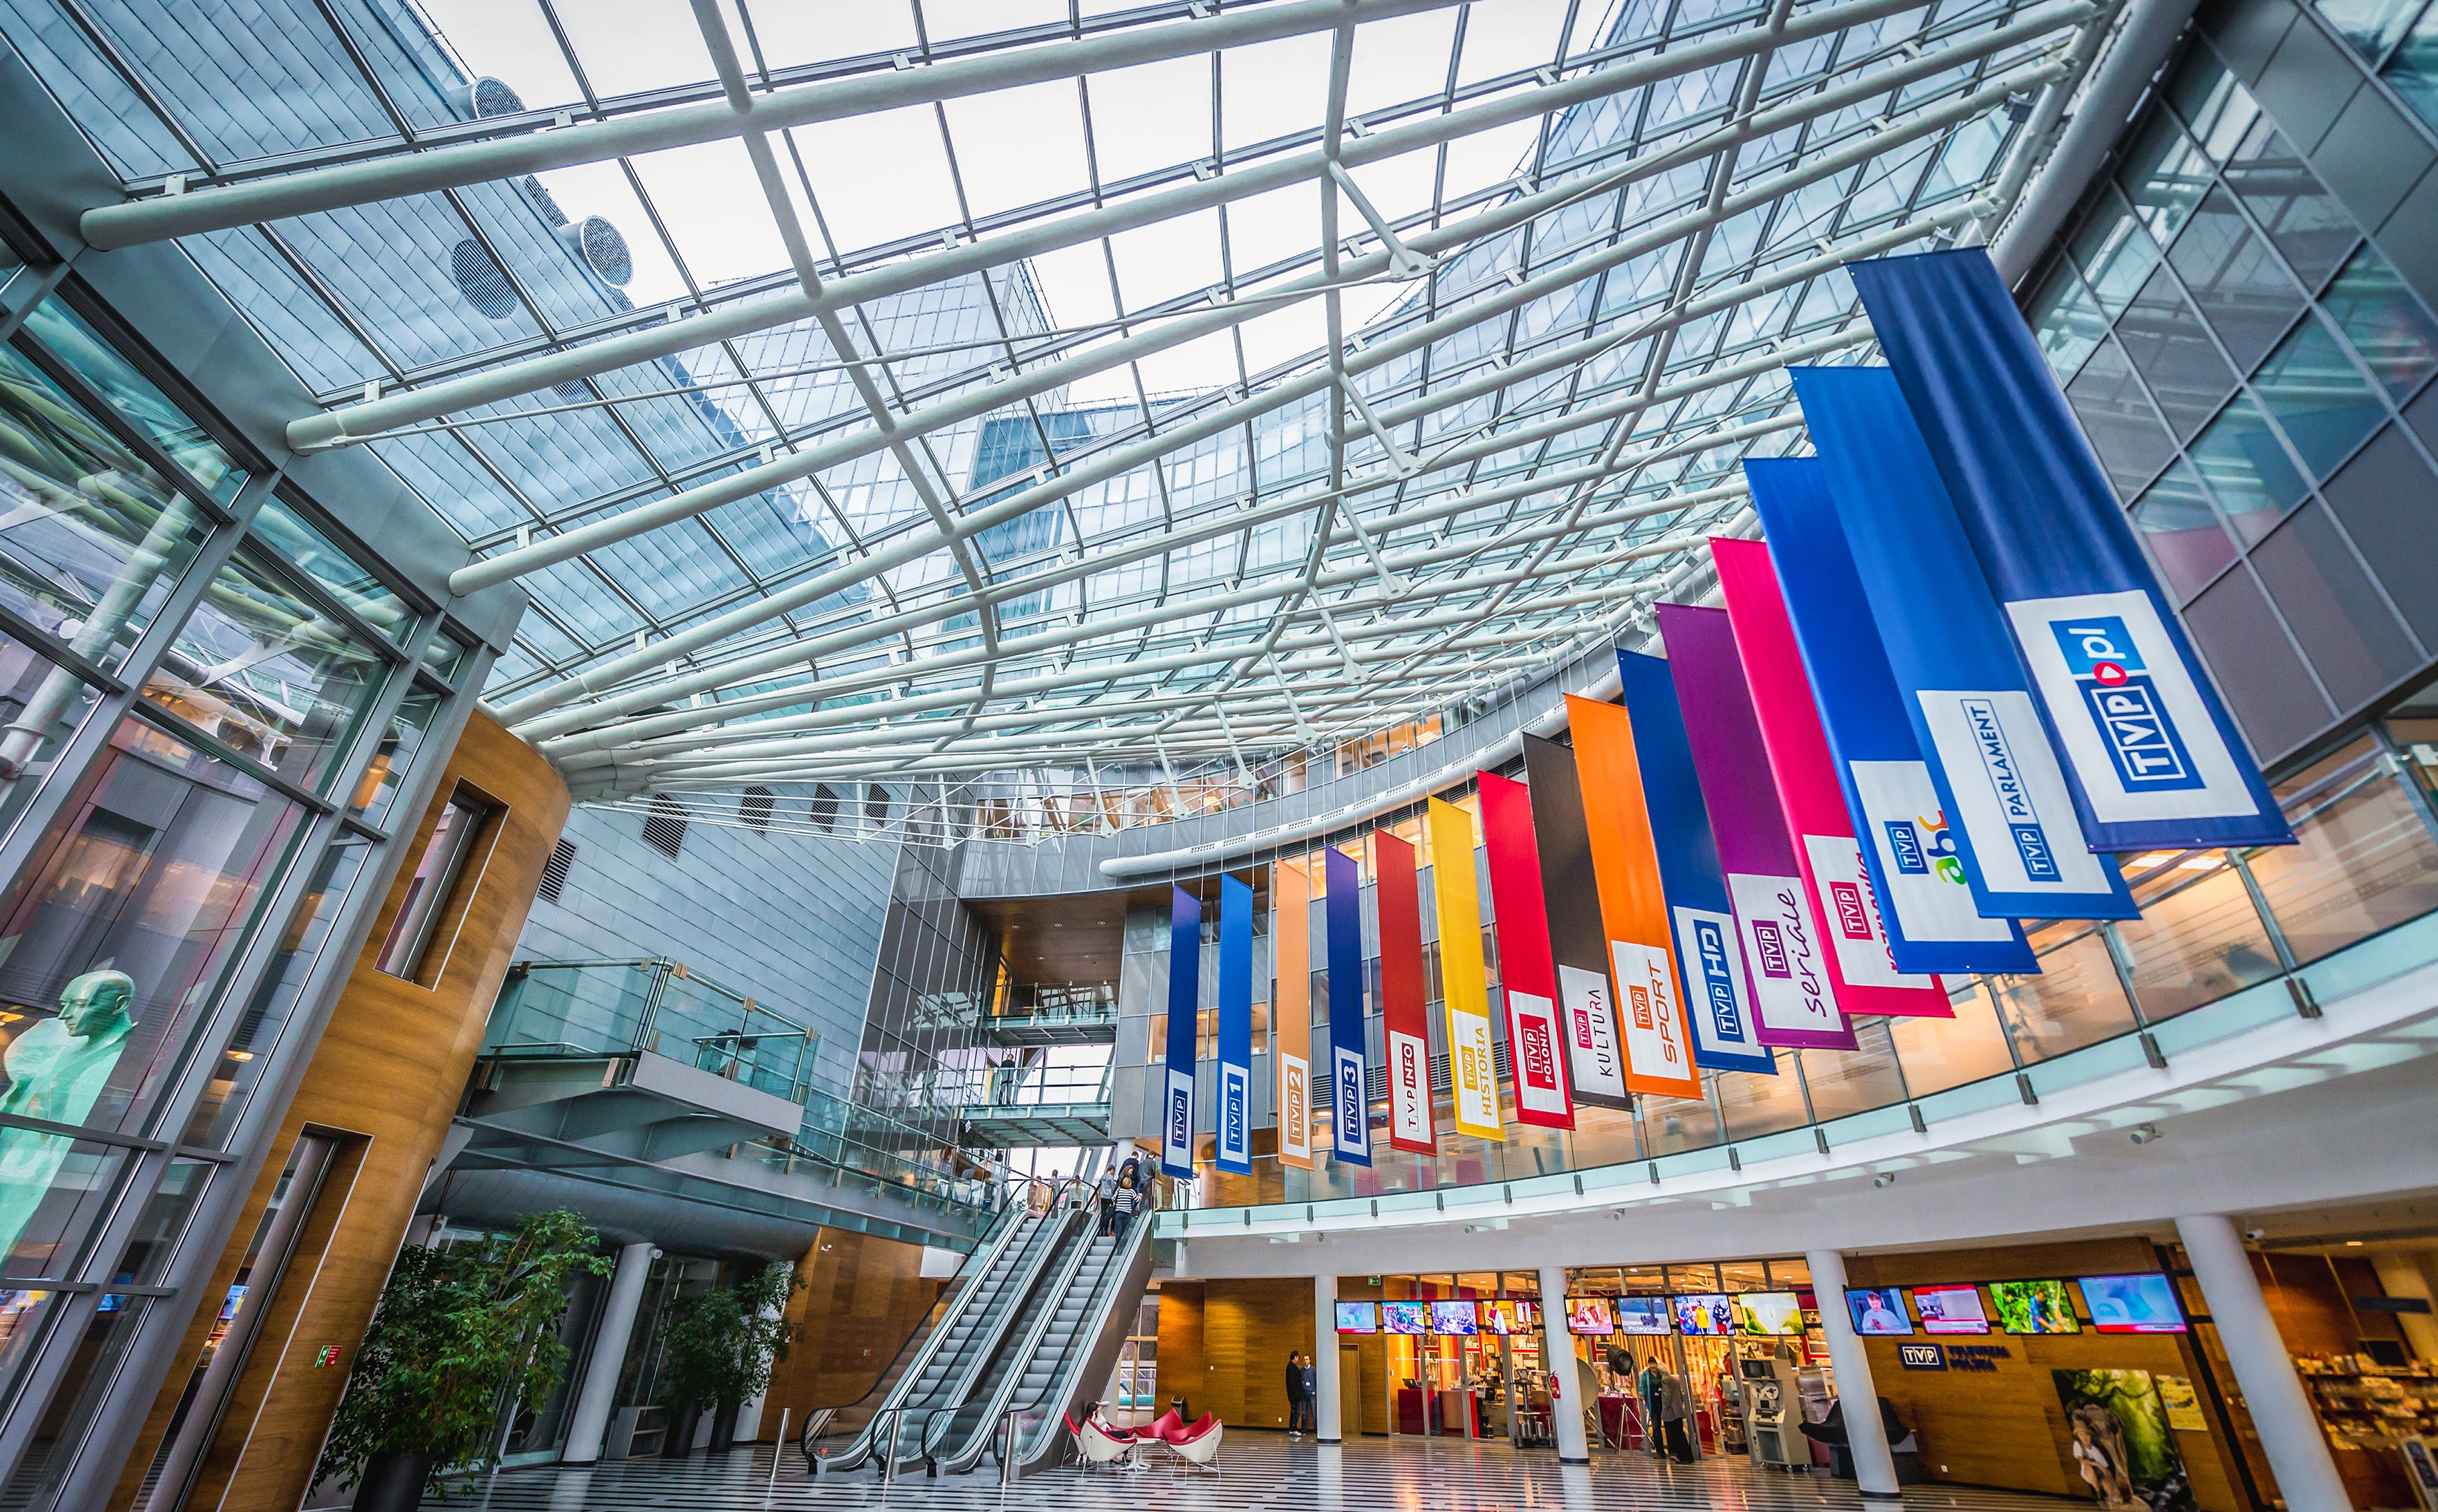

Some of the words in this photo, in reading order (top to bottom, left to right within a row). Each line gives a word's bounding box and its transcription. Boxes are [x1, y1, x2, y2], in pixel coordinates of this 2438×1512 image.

[2105, 693, 2173, 775] TVP
[1970, 706, 2028, 816] PARLAMENT
[1895, 829, 1918, 866] TVP
[1917, 809, 1968, 885] abc
[2020, 831, 2049, 872] TVP
[1839, 891, 1863, 930] TVP
[1700, 927, 1729, 978] HD
[1761, 929, 1783, 969] TVP
[1777, 888, 1827, 1018] seriale
[1634, 993, 1649, 1022] TVP
[1647, 958, 1678, 1064] SPORT
[1714, 986, 1735, 1031] TVP
[1577, 1016, 1589, 1043] TVP
[1587, 990, 1613, 1077] KULTURA
[1403, 1045, 1415, 1086] INFO
[1464, 1053, 1475, 1084] TVP
[1526, 1031, 1541, 1070] TVP
[1538, 1024, 1553, 1083] POLONIA
[1229, 1082, 1241, 1093] 1
[1289, 1070, 1301, 1089] 2
[1343, 1066, 1356, 1084] 3
[1475, 1027, 1493, 1116] HISTORIA
[1175, 1099, 1184, 1138] TVP
[1230, 1101, 1239, 1141] TVP
[1291, 1093, 1300, 1135] TVP
[1346, 1088, 1357, 1132] TVP
[1406, 1089, 1417, 1128] TVP
[1904, 1348, 1935, 1364] TVP
